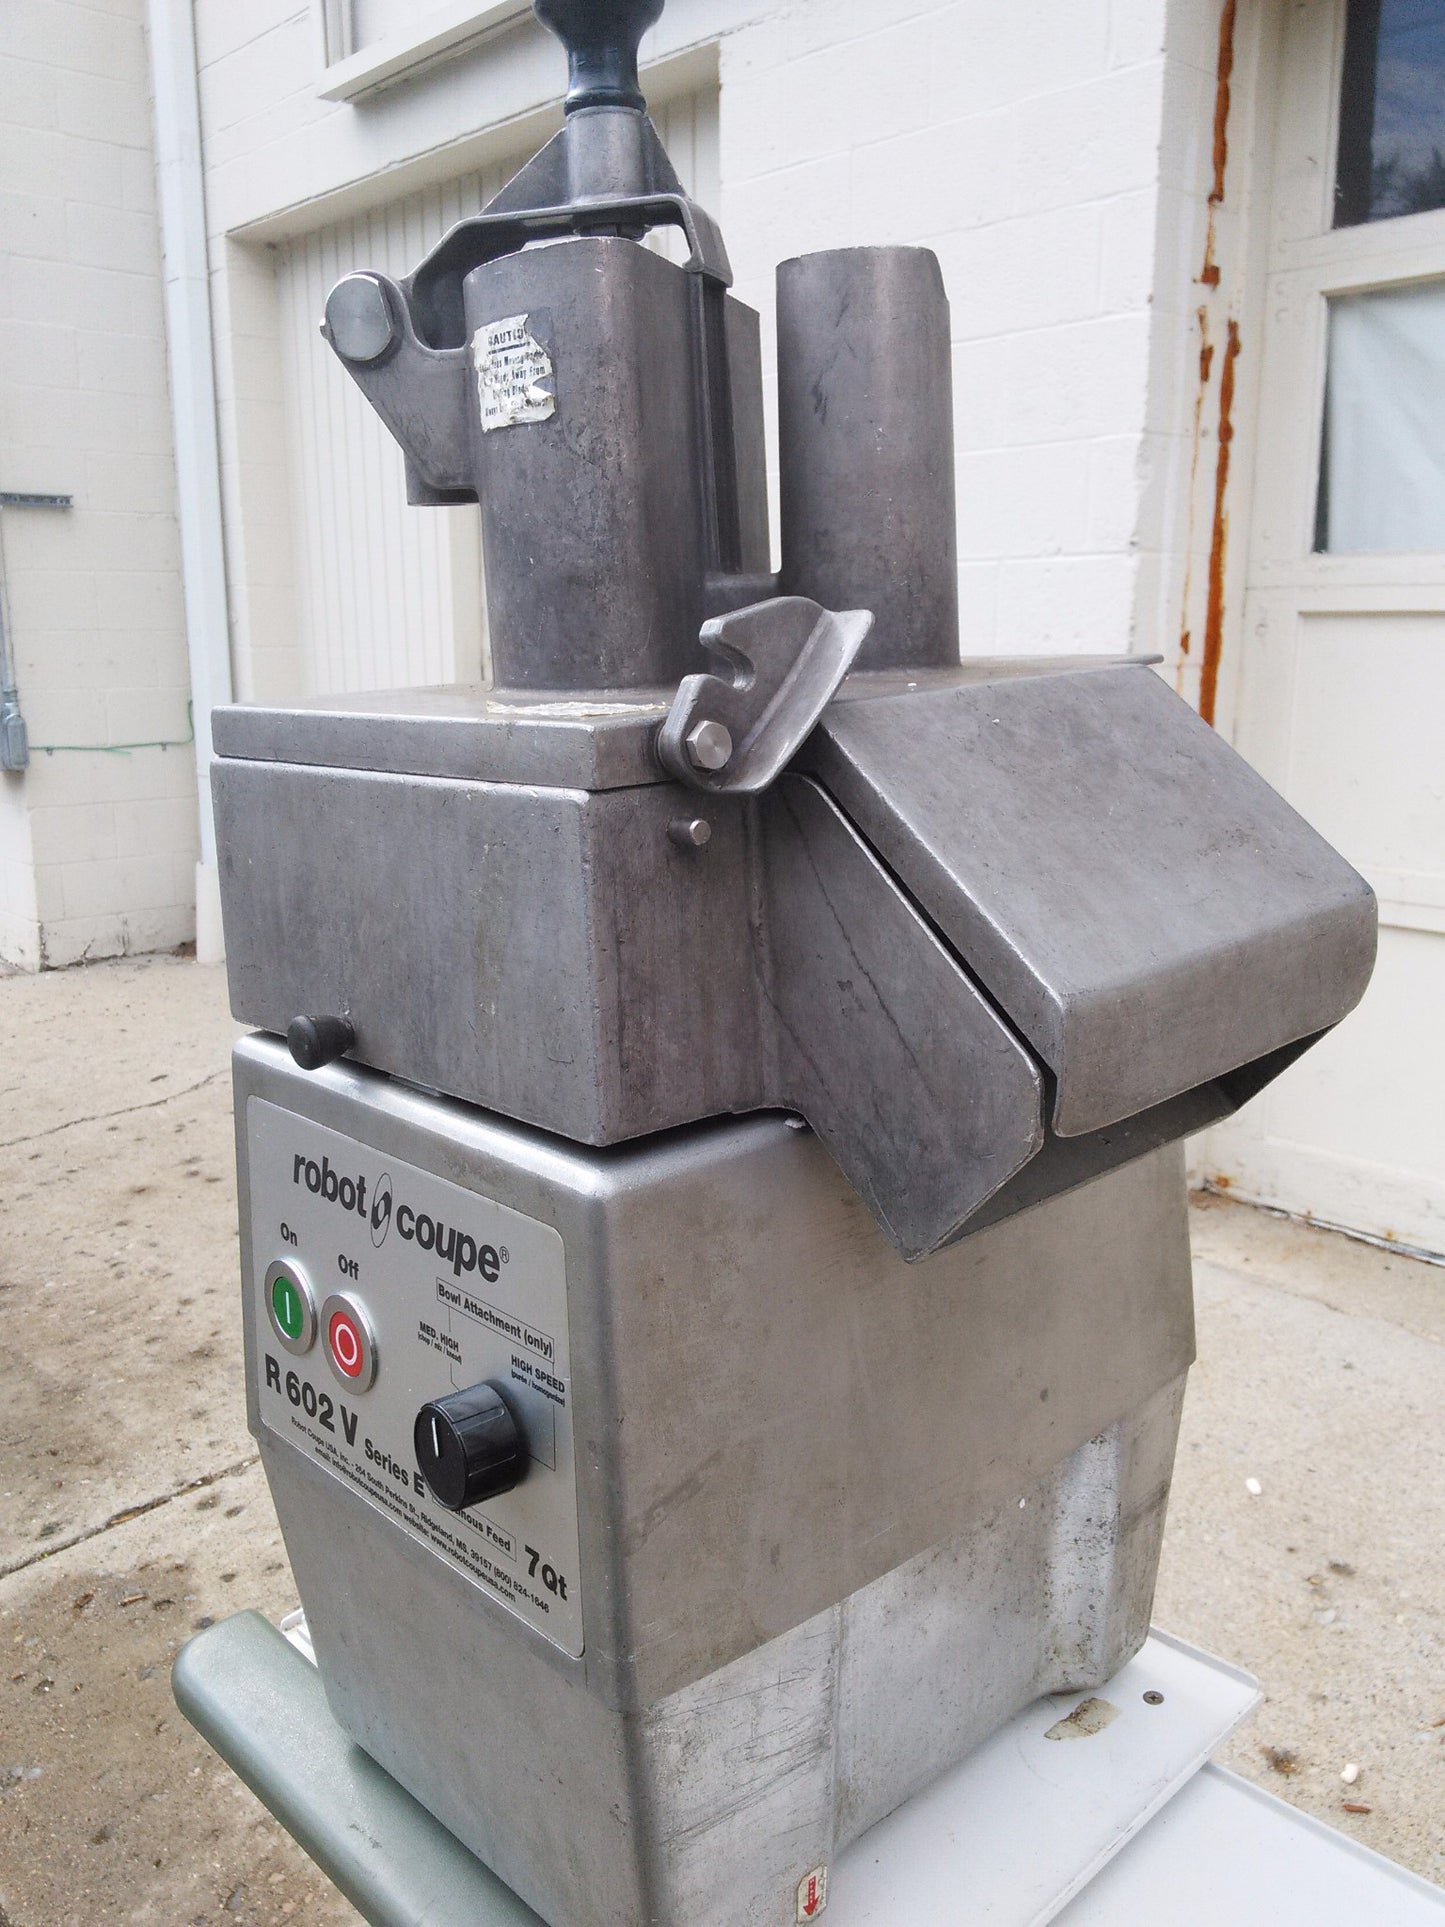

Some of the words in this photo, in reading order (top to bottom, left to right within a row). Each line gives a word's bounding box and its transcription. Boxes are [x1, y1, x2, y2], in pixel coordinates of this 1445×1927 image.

[487, 327, 525, 347] CAUTIO
[294, 1153, 367, 1218] robot
[280, 1222, 298, 1247] On
[338, 1253, 360, 1281] Off
[419, 1321, 439, 1340] MED.
[440, 1332, 459, 1352] HIGH
[438, 1283, 461, 1306] Bowl
[463, 1298, 521, 1339] Attachment
[524, 1329, 553, 1359] (only)
[511, 1354, 533, 1376] HIGH
[535, 1367, 565, 1393] SPEED
[265, 1353, 282, 1395] R
[285, 1370, 336, 1433] 602
[340, 1403, 358, 1448] V
[364, 1437, 409, 1487] Series
[413, 1471, 426, 1499] E
[486, 1524, 511, 1553] Feed
[470, 1549, 493, 1571] 39157
[493, 1566, 513, 1589] (800)
